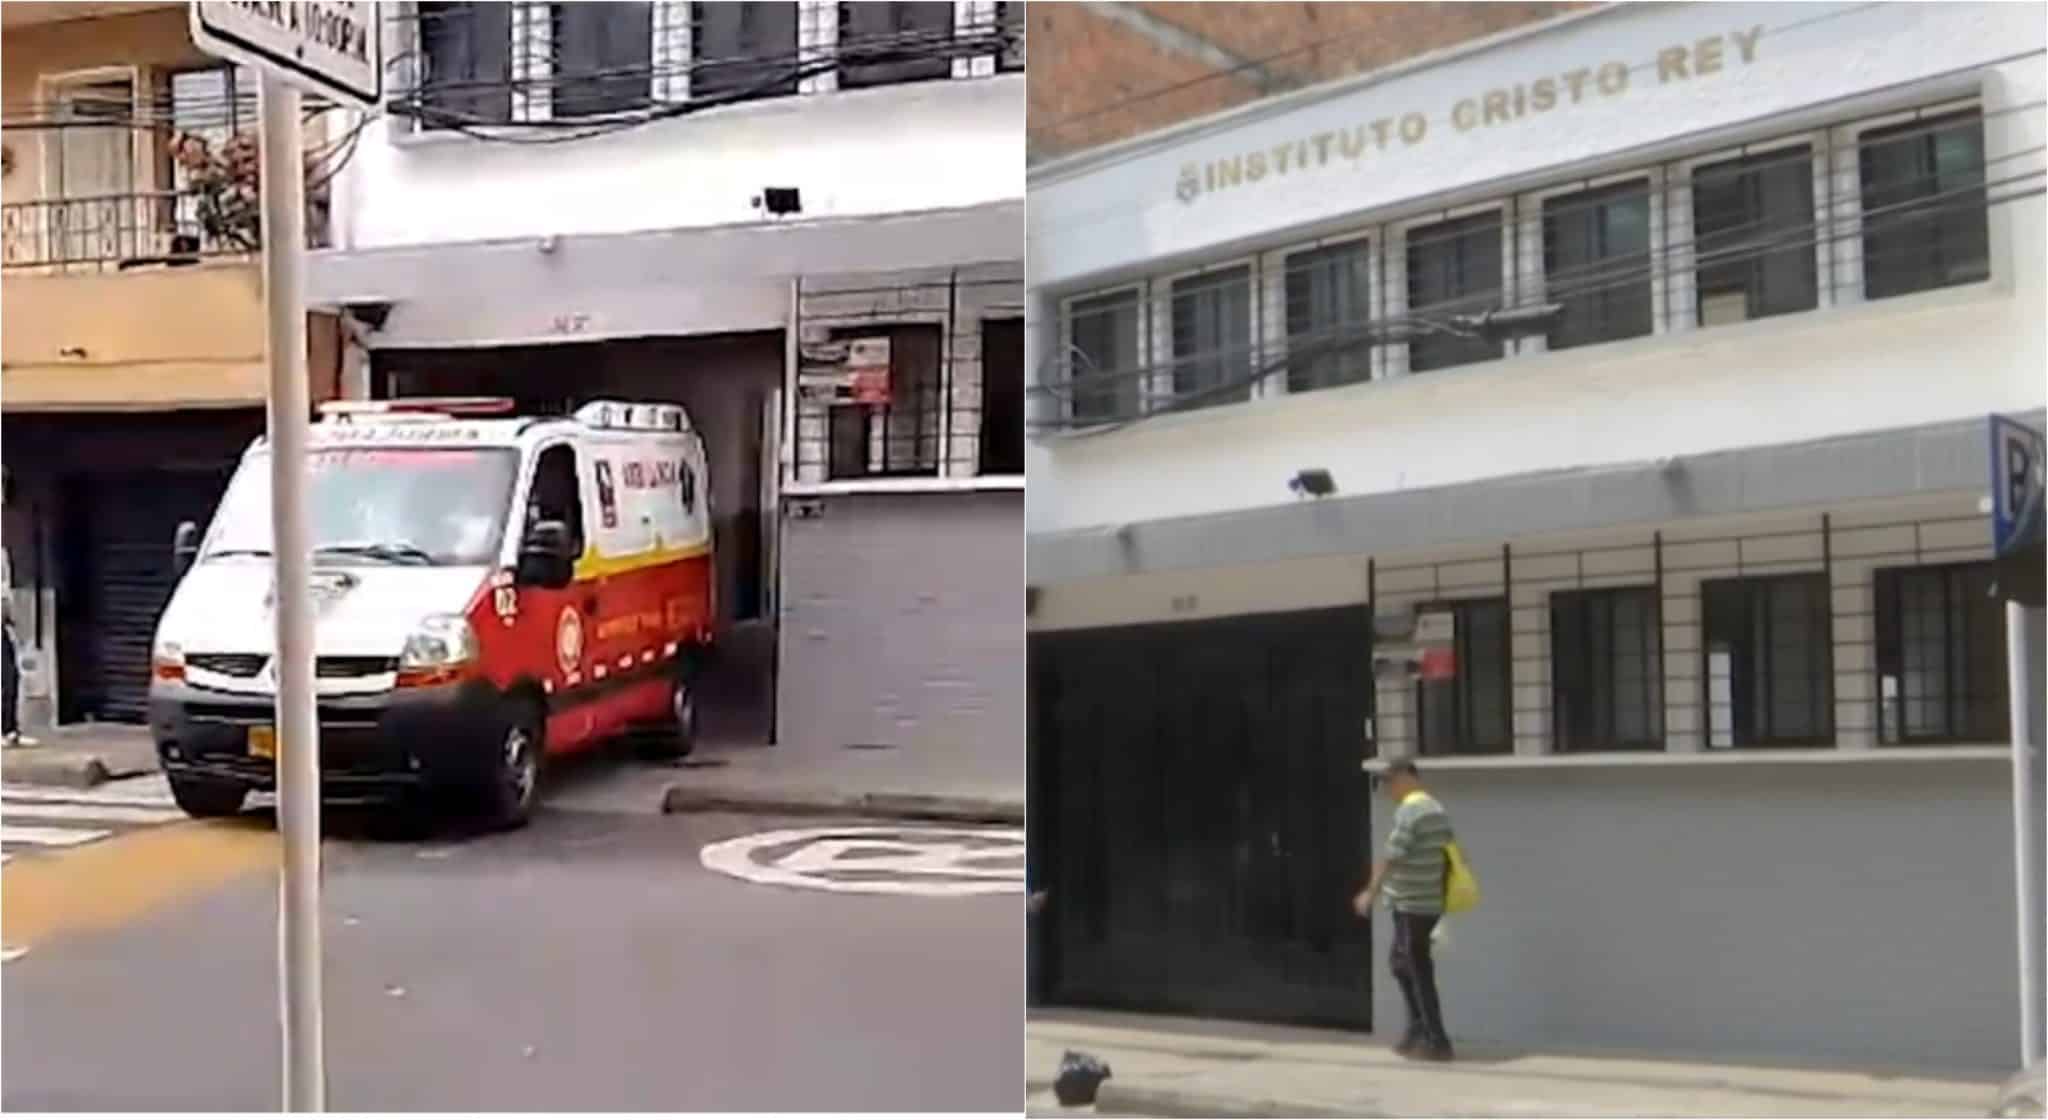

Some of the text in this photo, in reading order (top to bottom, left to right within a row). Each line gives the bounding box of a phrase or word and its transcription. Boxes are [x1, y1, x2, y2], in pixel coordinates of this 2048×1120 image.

[1204, 25, 1764, 192] INSTITUTO CRISTO REY
